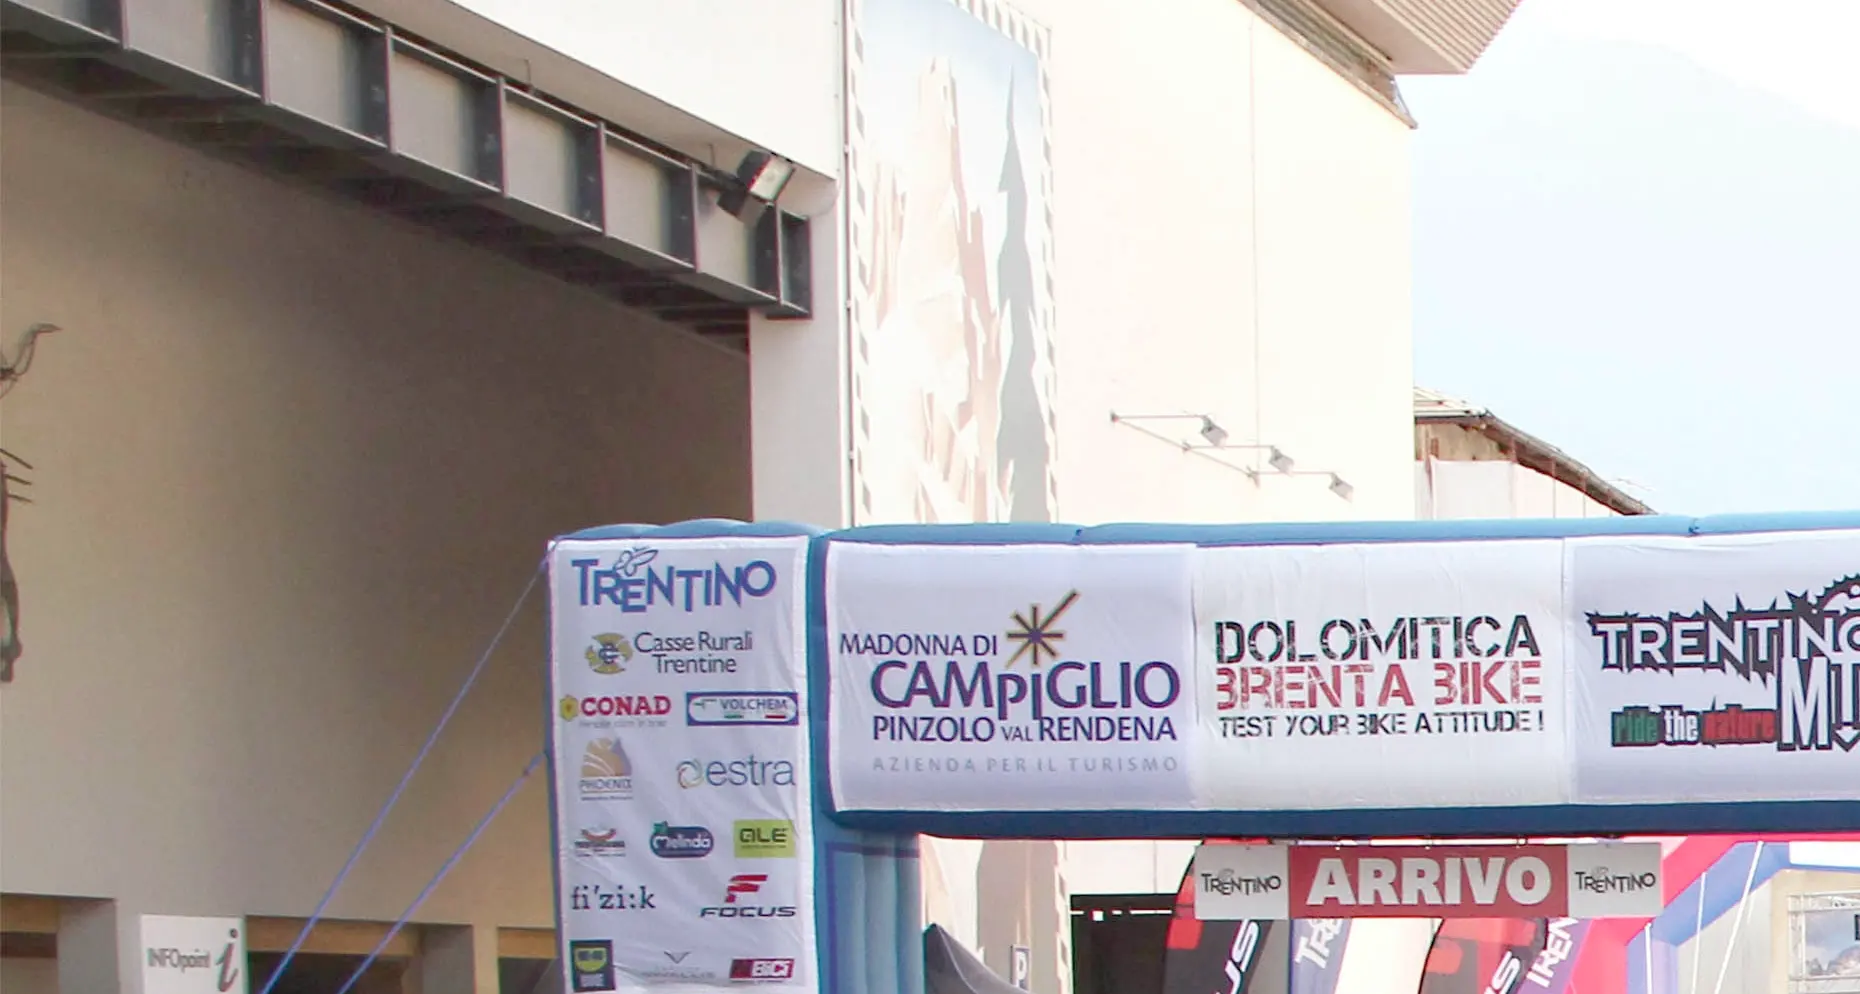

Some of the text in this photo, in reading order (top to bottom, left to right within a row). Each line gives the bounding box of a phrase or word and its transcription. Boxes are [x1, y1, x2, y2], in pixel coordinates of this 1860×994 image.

[571, 557, 777, 613] TRENTINO
[634, 631, 754, 653] Casse Rurali
[839, 633, 998, 656] MADONNA DI
[1214, 614, 1543, 664] DOLOMITICA
[652, 653, 738, 674] Trentine
[870, 660, 1181, 721] CAMPIGLIO
[1216, 660, 1544, 711] BRENTA BIKE
[581, 695, 672, 717] CONAD
[720, 698, 788, 711] VOLCHEM
[872, 715, 1178, 742] PINZOLO VAL RENDENA
[1218, 714, 1279, 739] TEST
[1285, 713, 1351, 737] YOUR
[1357, 712, 1407, 736] BIKE
[705, 758, 797, 787] estra
[872, 756, 1179, 773] AZIENDA PER IL TURISMO
[1201, 855, 1657, 907] TRENTINO ARRIVO TRENTINO
[699, 906, 797, 918] FOCUS
